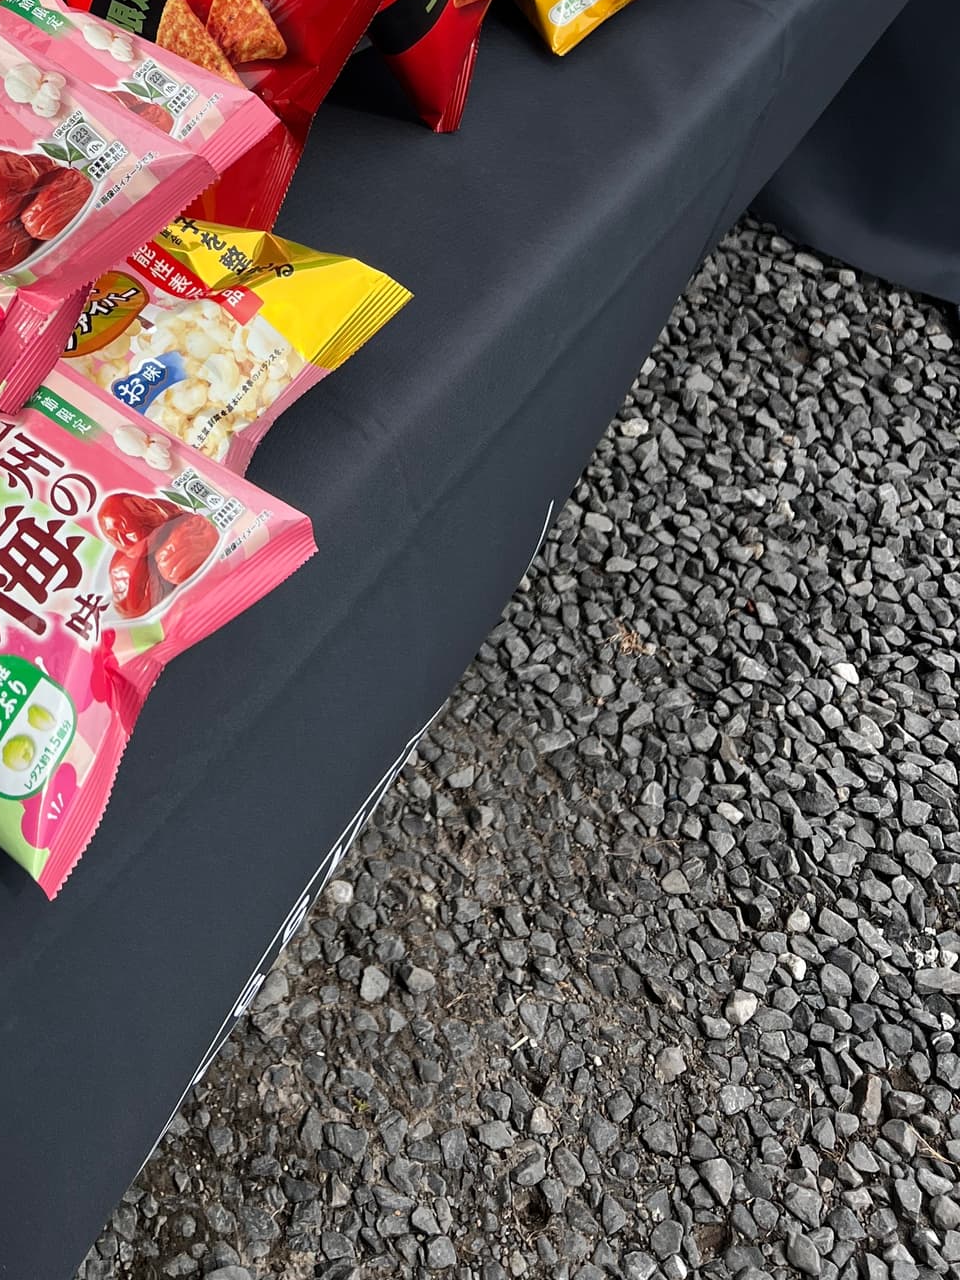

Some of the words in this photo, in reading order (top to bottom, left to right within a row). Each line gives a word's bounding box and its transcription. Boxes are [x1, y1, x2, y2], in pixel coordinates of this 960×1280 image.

[71, 127, 89, 144] 223
[23, 719, 72, 791] レタス約1.5個分
